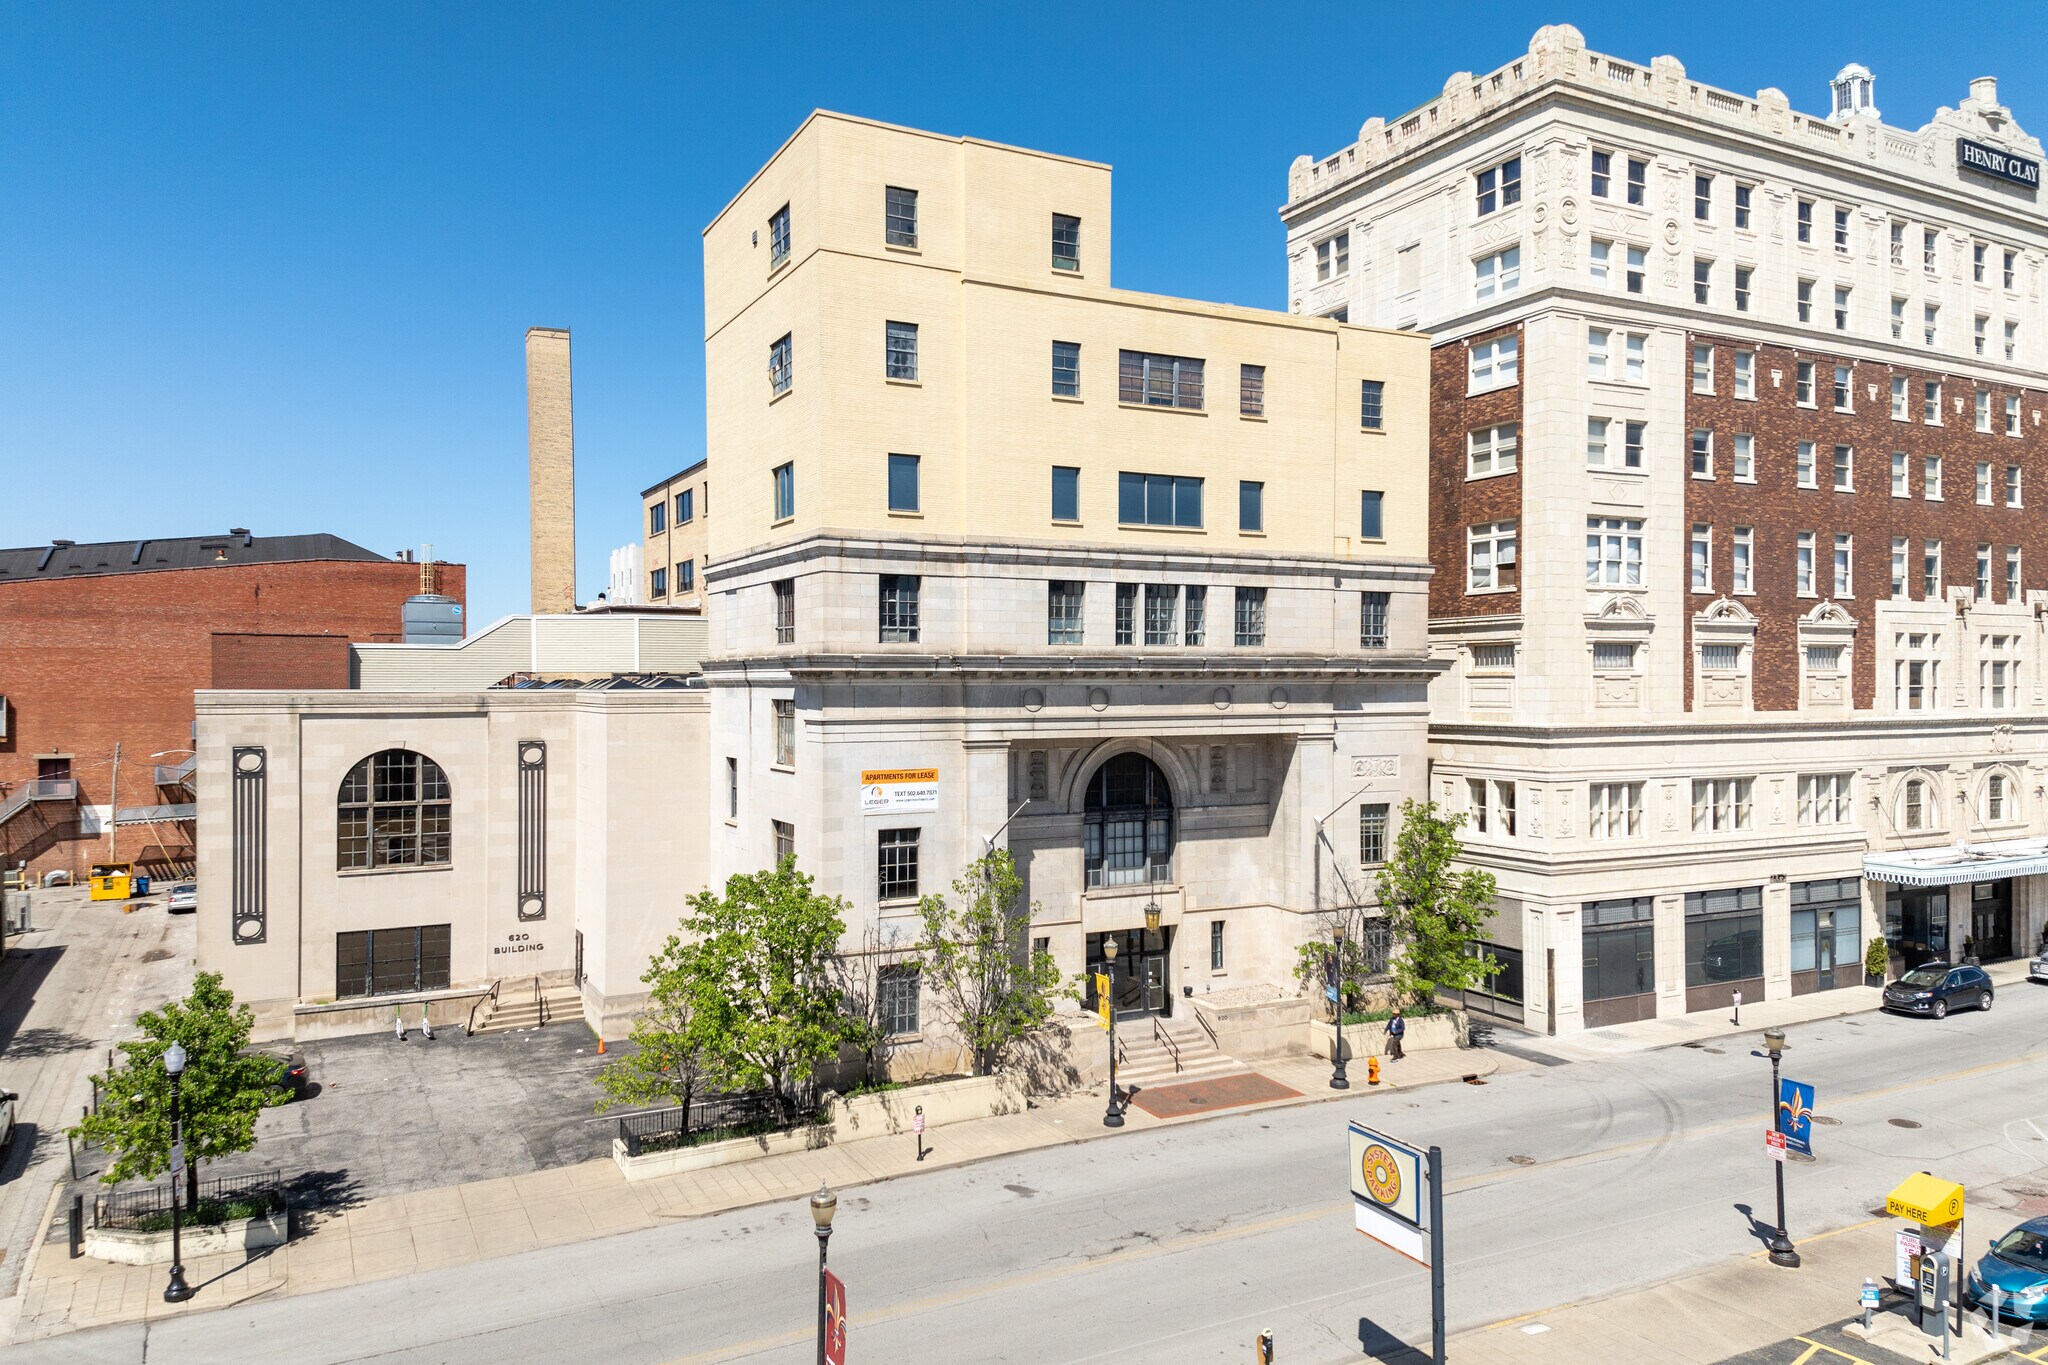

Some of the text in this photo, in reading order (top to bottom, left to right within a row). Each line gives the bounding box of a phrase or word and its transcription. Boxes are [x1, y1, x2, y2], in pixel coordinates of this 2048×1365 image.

[1964, 144, 2038, 182] HENRY CLAY
[865, 773, 904, 781] APARTMENTS
[905, 772, 917, 780] FOR
[508, 933, 530, 942] 620
[494, 943, 544, 955] BUILDING
[1366, 1149, 1396, 1174] SYSTEM
[1366, 1170, 1397, 1199] PARKING
[1890, 1201, 1927, 1222] PAY HERE
[1902, 1235, 1921, 1245] PUBL
